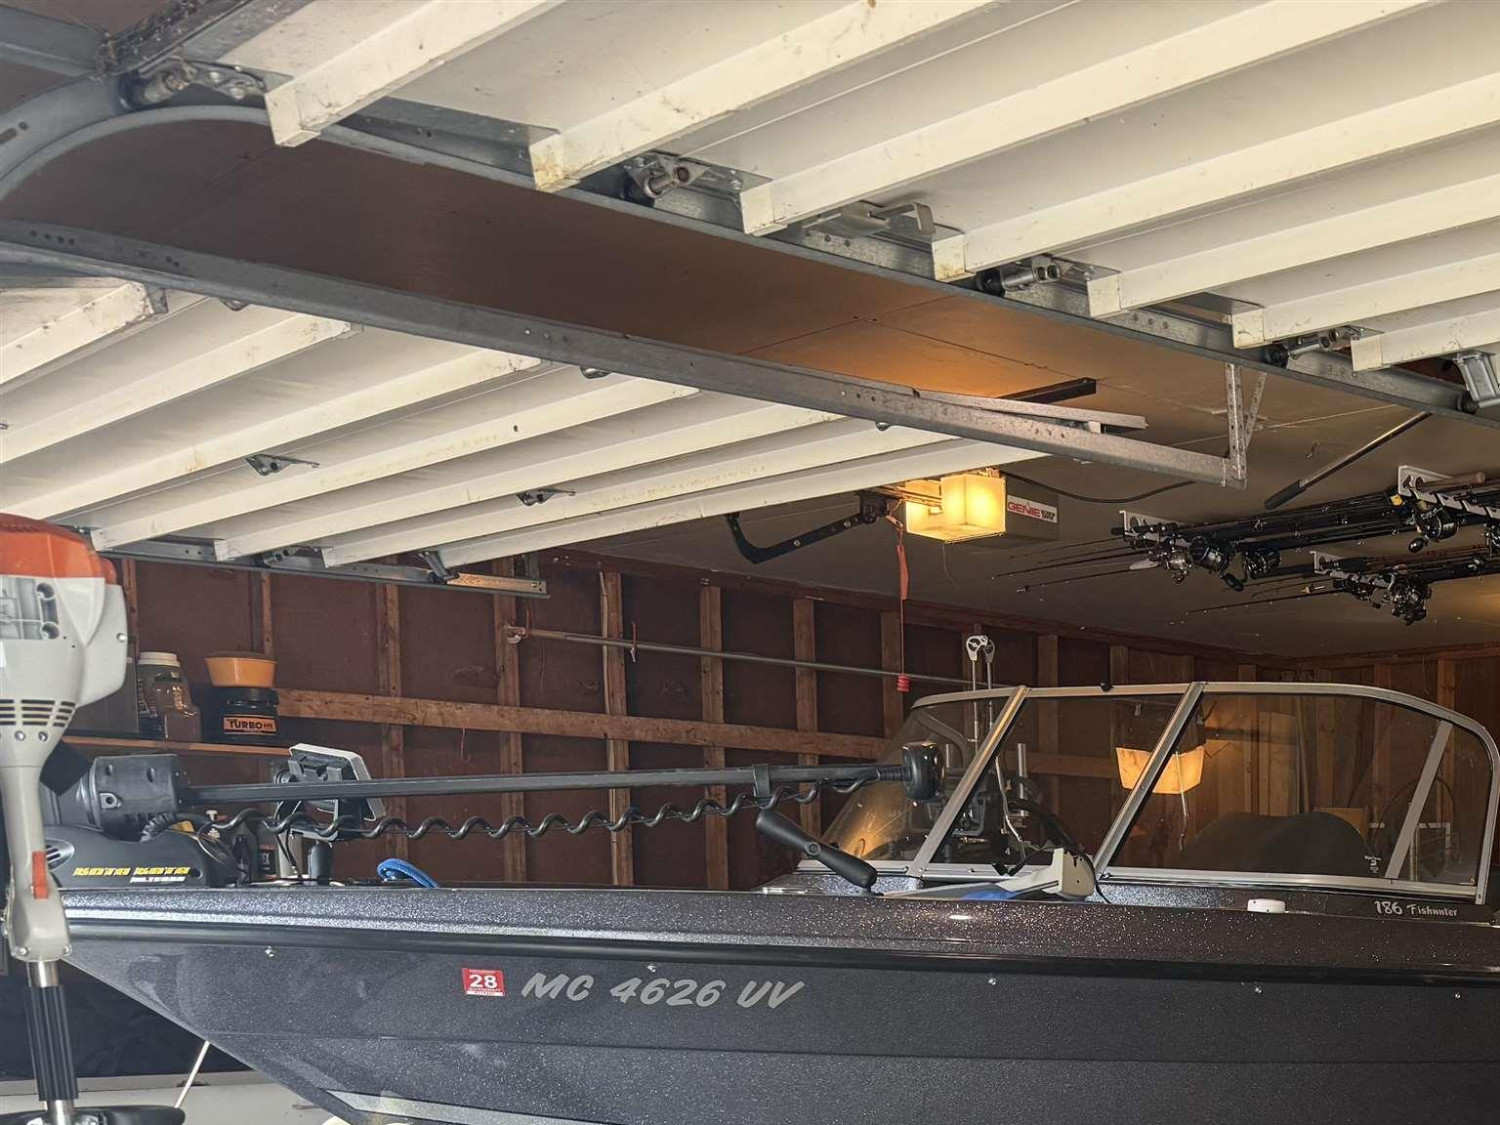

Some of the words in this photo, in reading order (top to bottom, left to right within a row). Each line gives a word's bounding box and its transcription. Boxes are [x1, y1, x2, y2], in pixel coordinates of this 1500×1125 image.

[1008, 501, 1041, 518] GENIE
[227, 719, 263, 730] TURBO
[1374, 900, 1403, 915] 186
[470, 974, 498, 989] 28
[521, 971, 594, 1001] MC
[610, 976, 726, 1007] 4626
[736, 981, 805, 1009] UV
